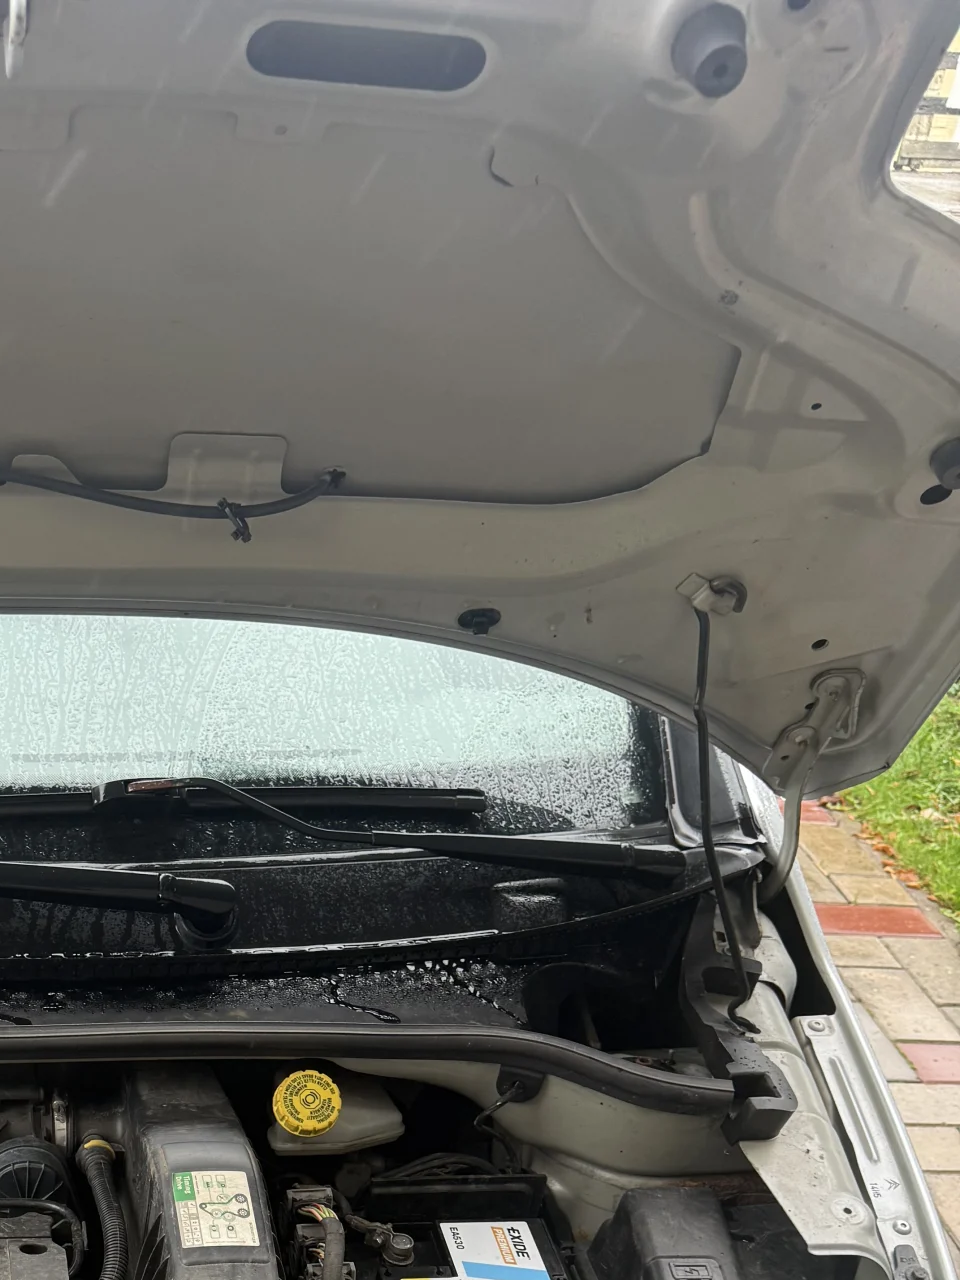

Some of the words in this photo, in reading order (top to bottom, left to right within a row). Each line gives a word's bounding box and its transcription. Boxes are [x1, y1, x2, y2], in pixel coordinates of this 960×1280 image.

[449, 1226, 465, 1250] EA530
[493, 1228, 514, 1264] PREMIUM
[507, 1226, 530, 1259] EXIDE
